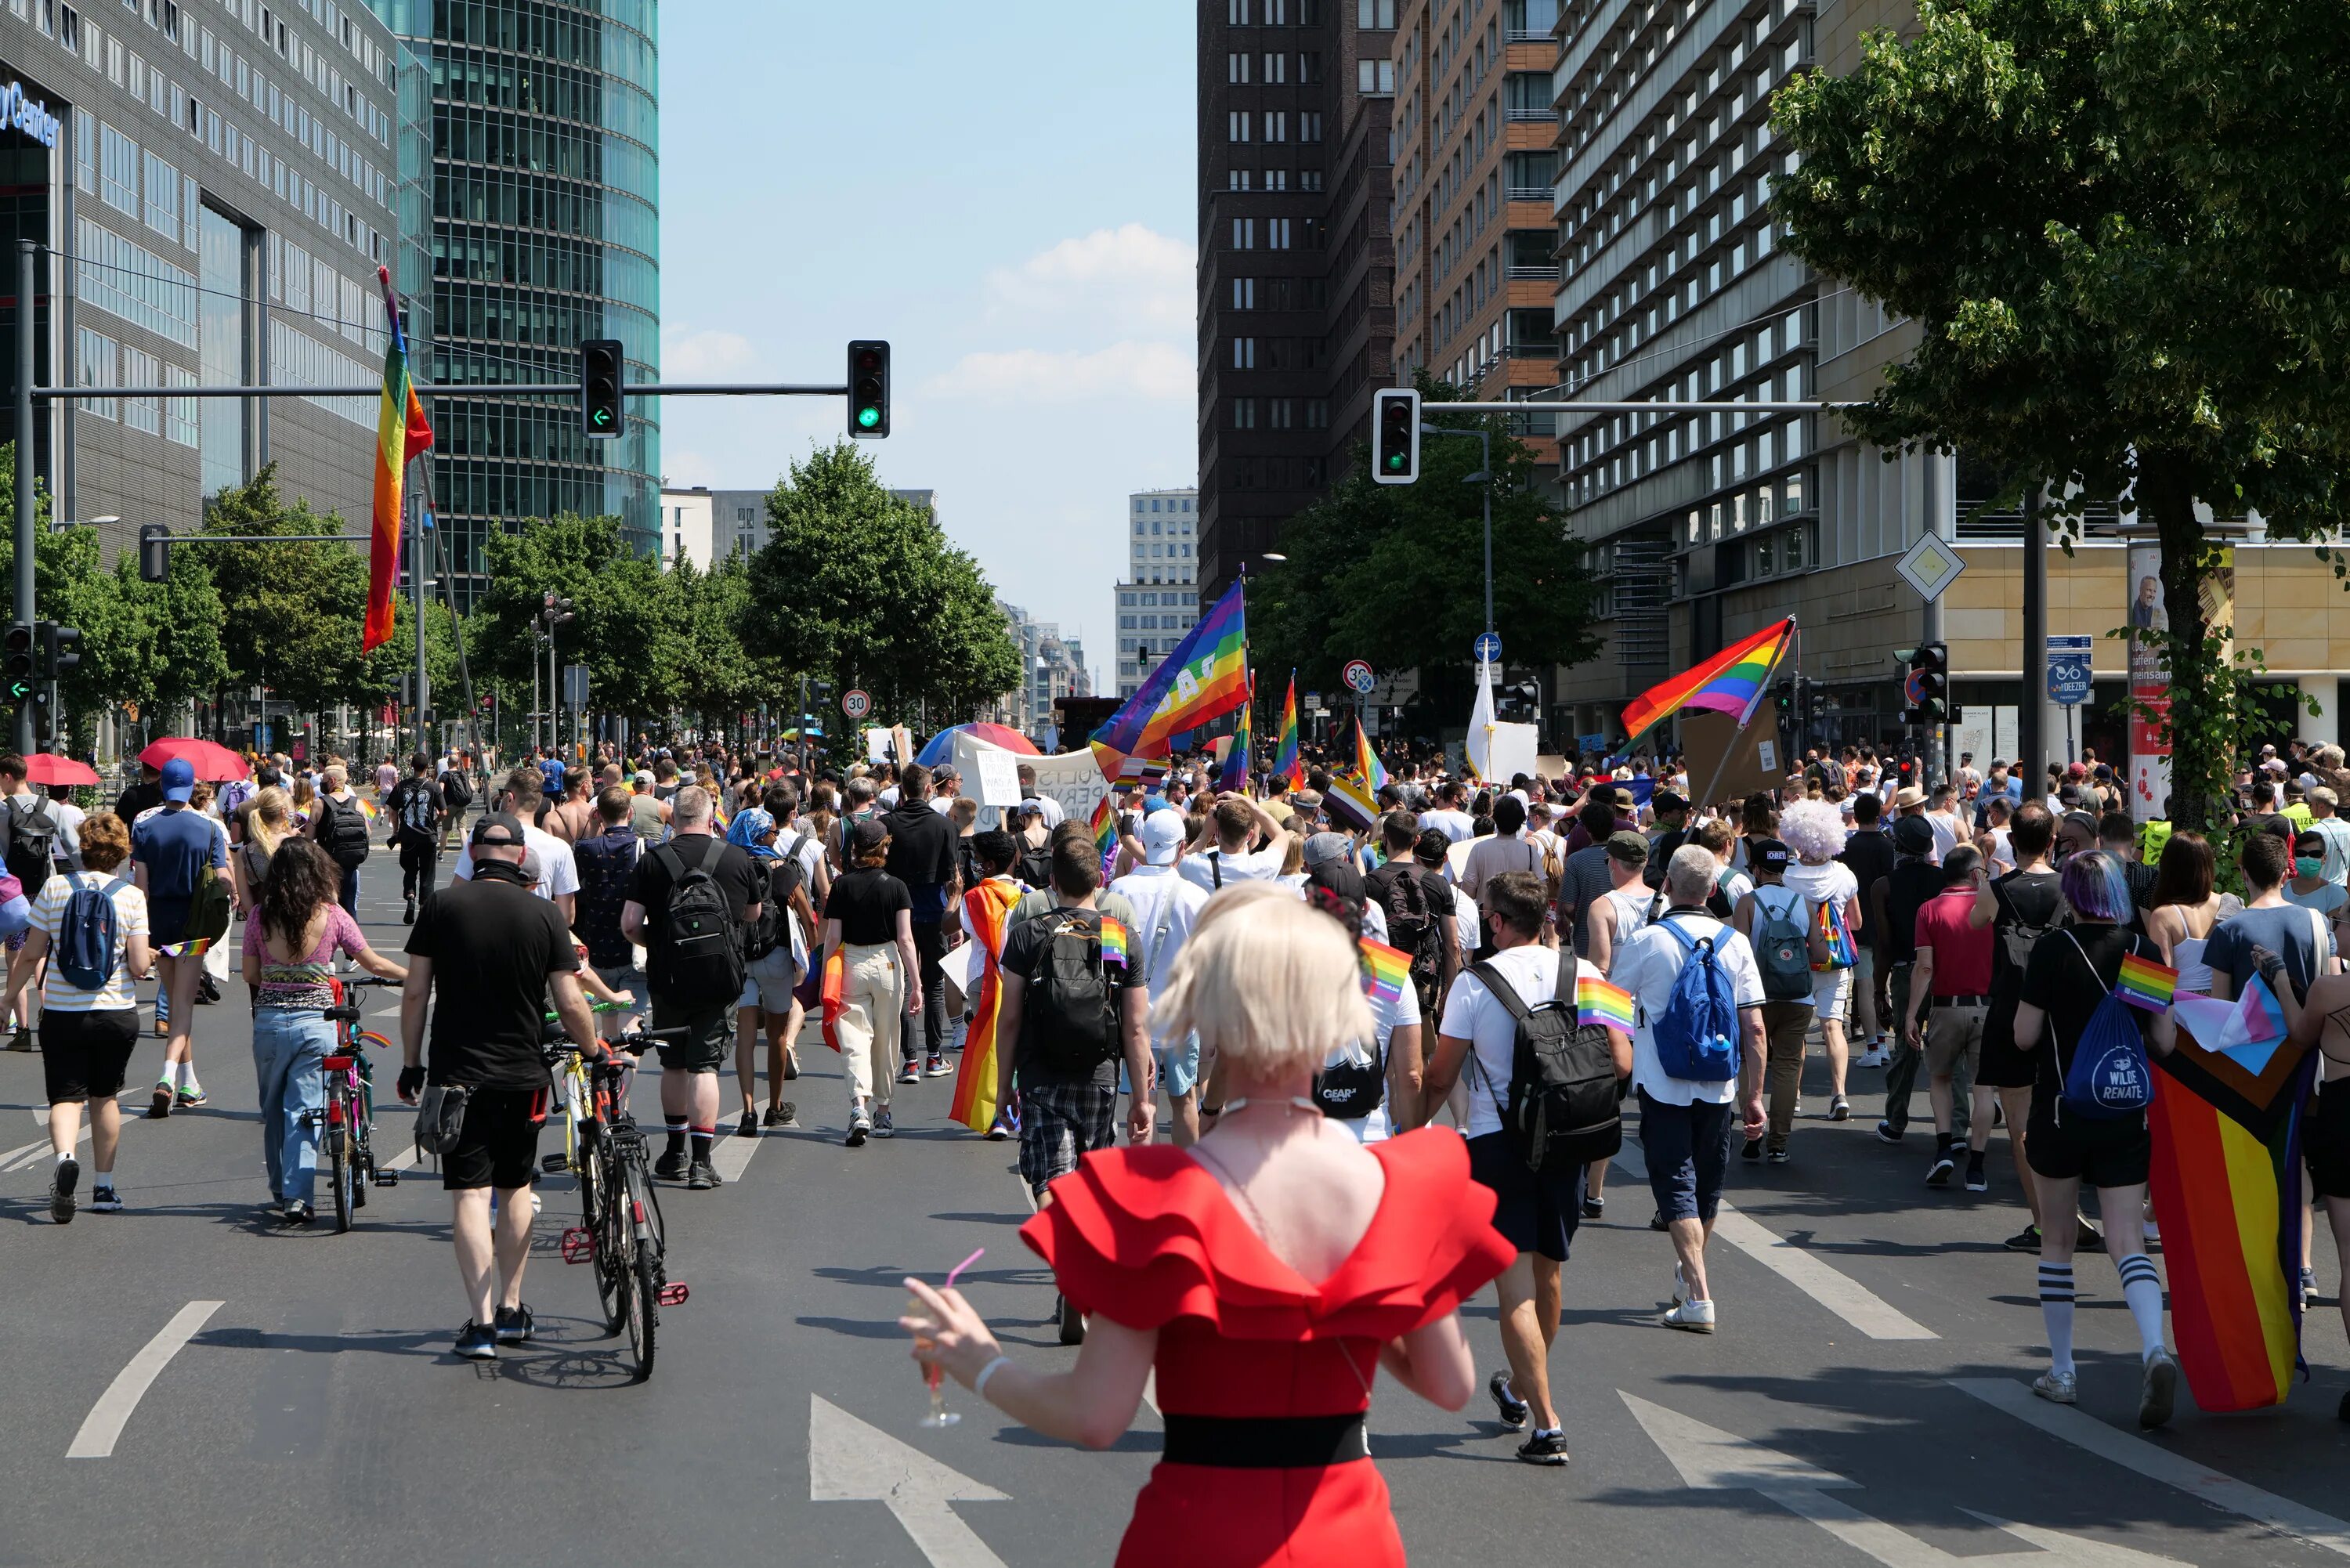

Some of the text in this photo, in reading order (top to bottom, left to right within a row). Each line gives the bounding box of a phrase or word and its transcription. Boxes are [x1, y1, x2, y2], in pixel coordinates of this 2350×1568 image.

[2064, 681, 2087, 692] DEEZER
[848, 697, 864, 710] 30
[980, 752, 1013, 764] THE FIRST
[985, 764, 1012, 776] PRIDE
[984, 777, 1003, 788] WAS
[991, 789, 1013, 801] RIOT
[2110, 1070, 2138, 1085] WILDE
[1323, 1089, 1352, 1098] GEAR
[2102, 1086, 2143, 1099] RENATE
